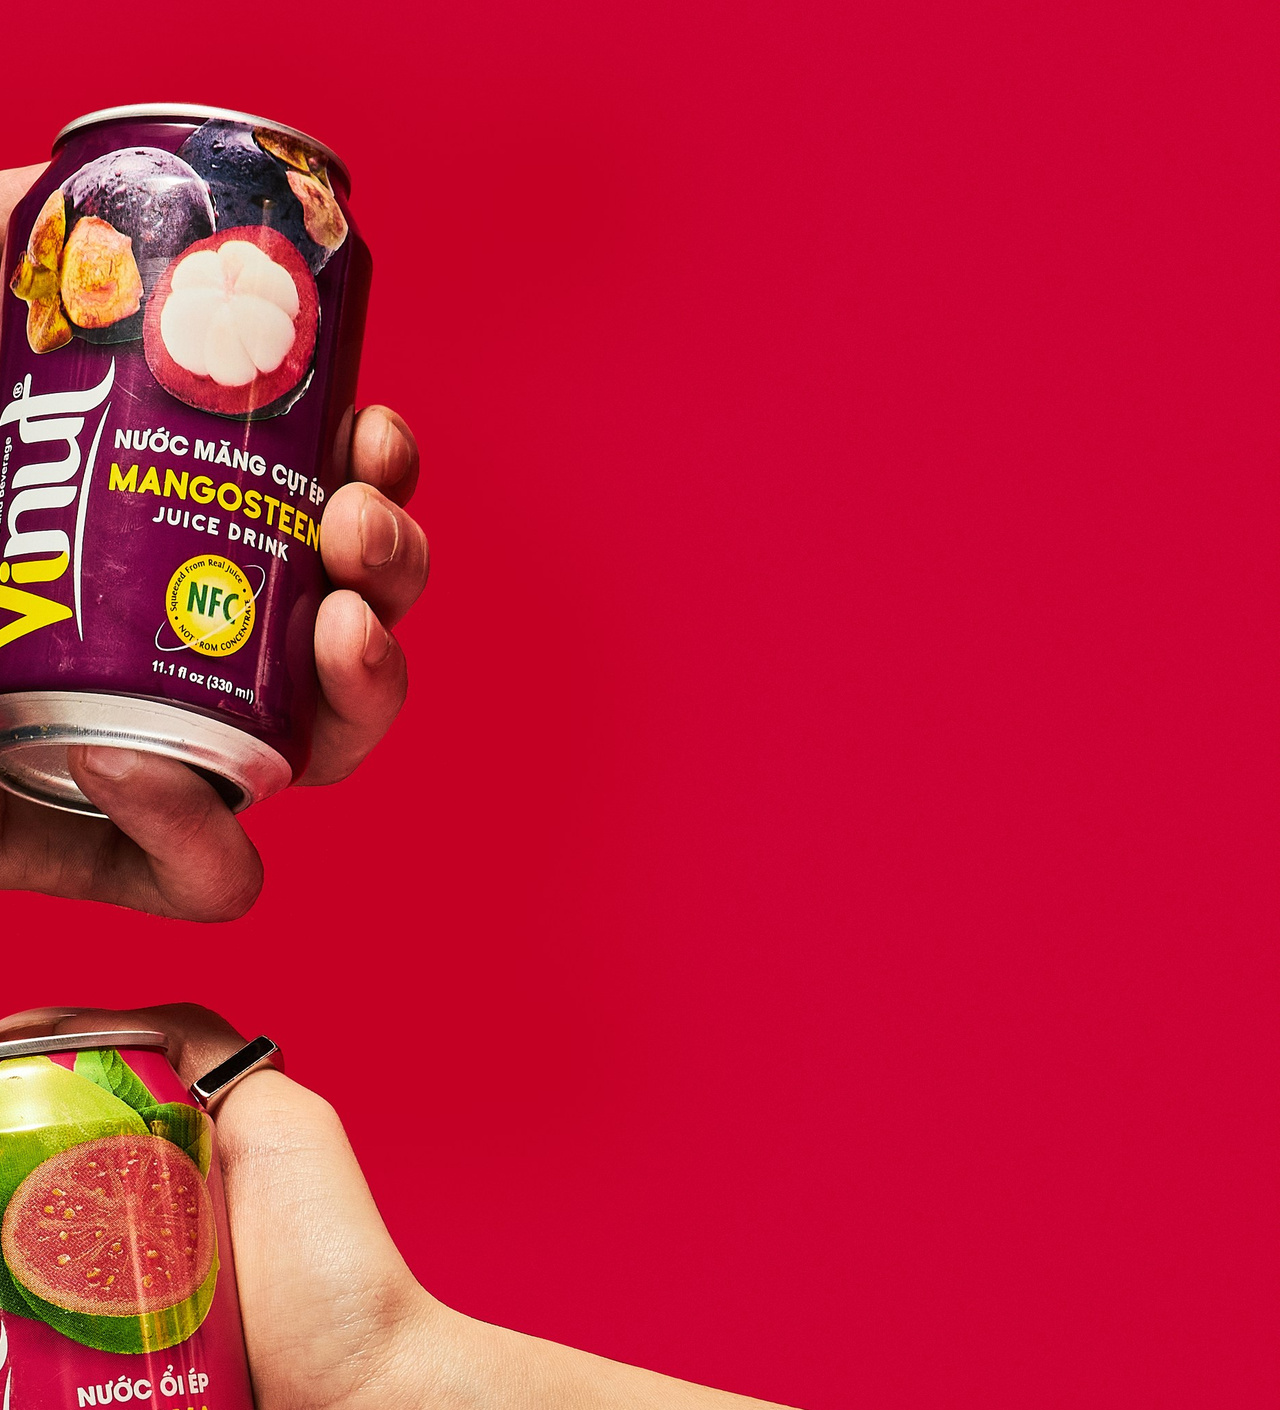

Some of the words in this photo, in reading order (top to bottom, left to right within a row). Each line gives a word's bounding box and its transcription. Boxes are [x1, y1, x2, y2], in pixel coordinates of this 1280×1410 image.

[114, 427, 188, 456] NƯỚC
[193, 439, 267, 476] MĂNG
[272, 464, 308, 497] CỤT
[308, 478, 325, 506] ÉP
[108, 463, 320, 552] MANGOSTEEN
[152, 506, 220, 536] JUICE
[227, 522, 288, 561] DRINK
[170, 571, 186, 612] Squeezed
[185, 560, 205, 574] From
[208, 559, 225, 569] Real
[225, 565, 242, 584] Juice
[187, 581, 239, 625] NFC
[179, 624, 195, 642] NOT
[152, 660, 175, 676] 11.1
[178, 666, 187, 679] fl
[189, 672, 204, 685] oz
[206, 675, 233, 694] (330
[235, 687, 254, 705] ml)
[77, 1375, 153, 1408] NƯỚC
[160, 1364, 185, 1397] ỔI
[188, 1367, 209, 1394] ÉP
